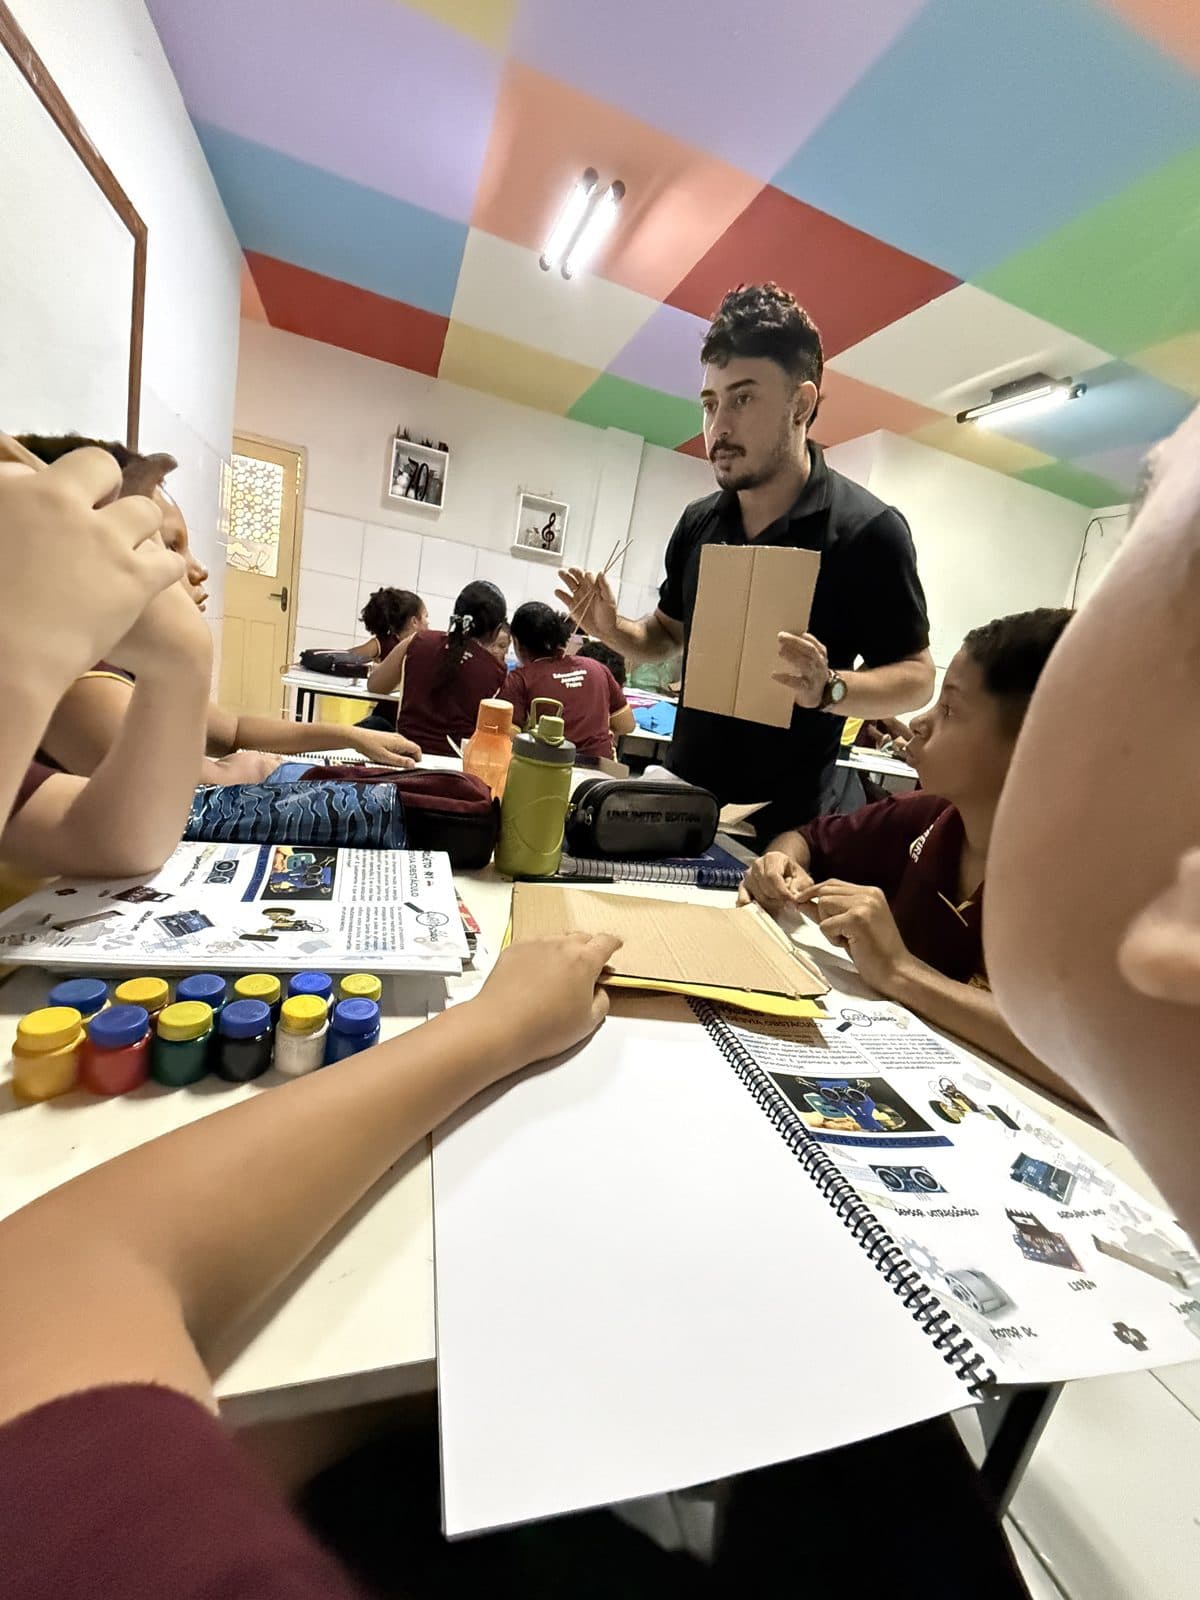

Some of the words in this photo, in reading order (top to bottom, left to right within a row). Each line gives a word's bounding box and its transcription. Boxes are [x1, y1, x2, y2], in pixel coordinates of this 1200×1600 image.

[404, 456, 429, 501] 70
[606, 810, 662, 823] UNLIMITED
[989, 1326, 1020, 1339] MOTOR
